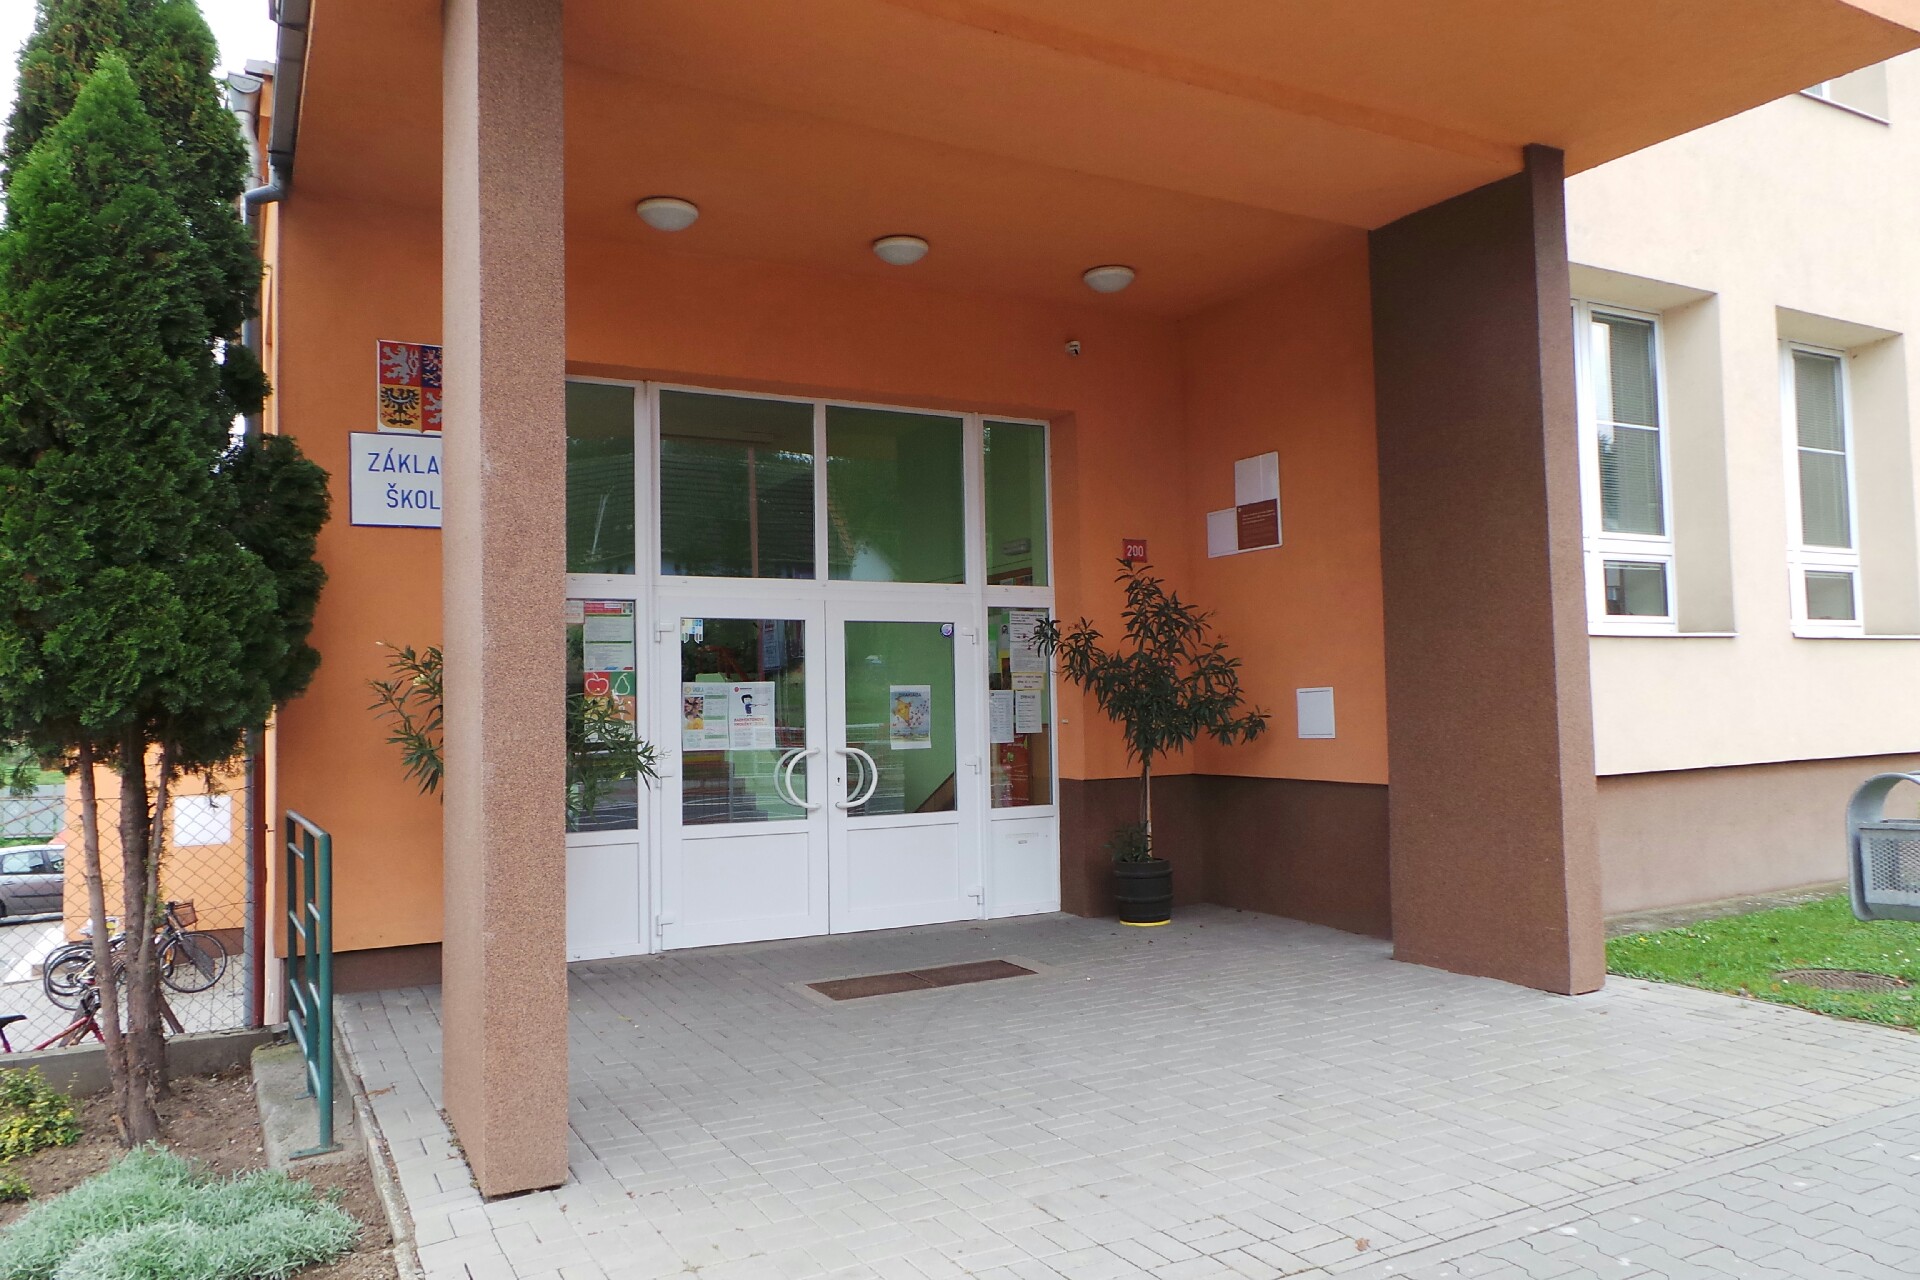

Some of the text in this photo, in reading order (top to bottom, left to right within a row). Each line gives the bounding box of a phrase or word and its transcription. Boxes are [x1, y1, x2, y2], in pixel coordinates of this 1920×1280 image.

[367, 447, 440, 475] ZÁKLA
[386, 482, 441, 510] ŠKOL
[1127, 544, 1144, 557] 200
